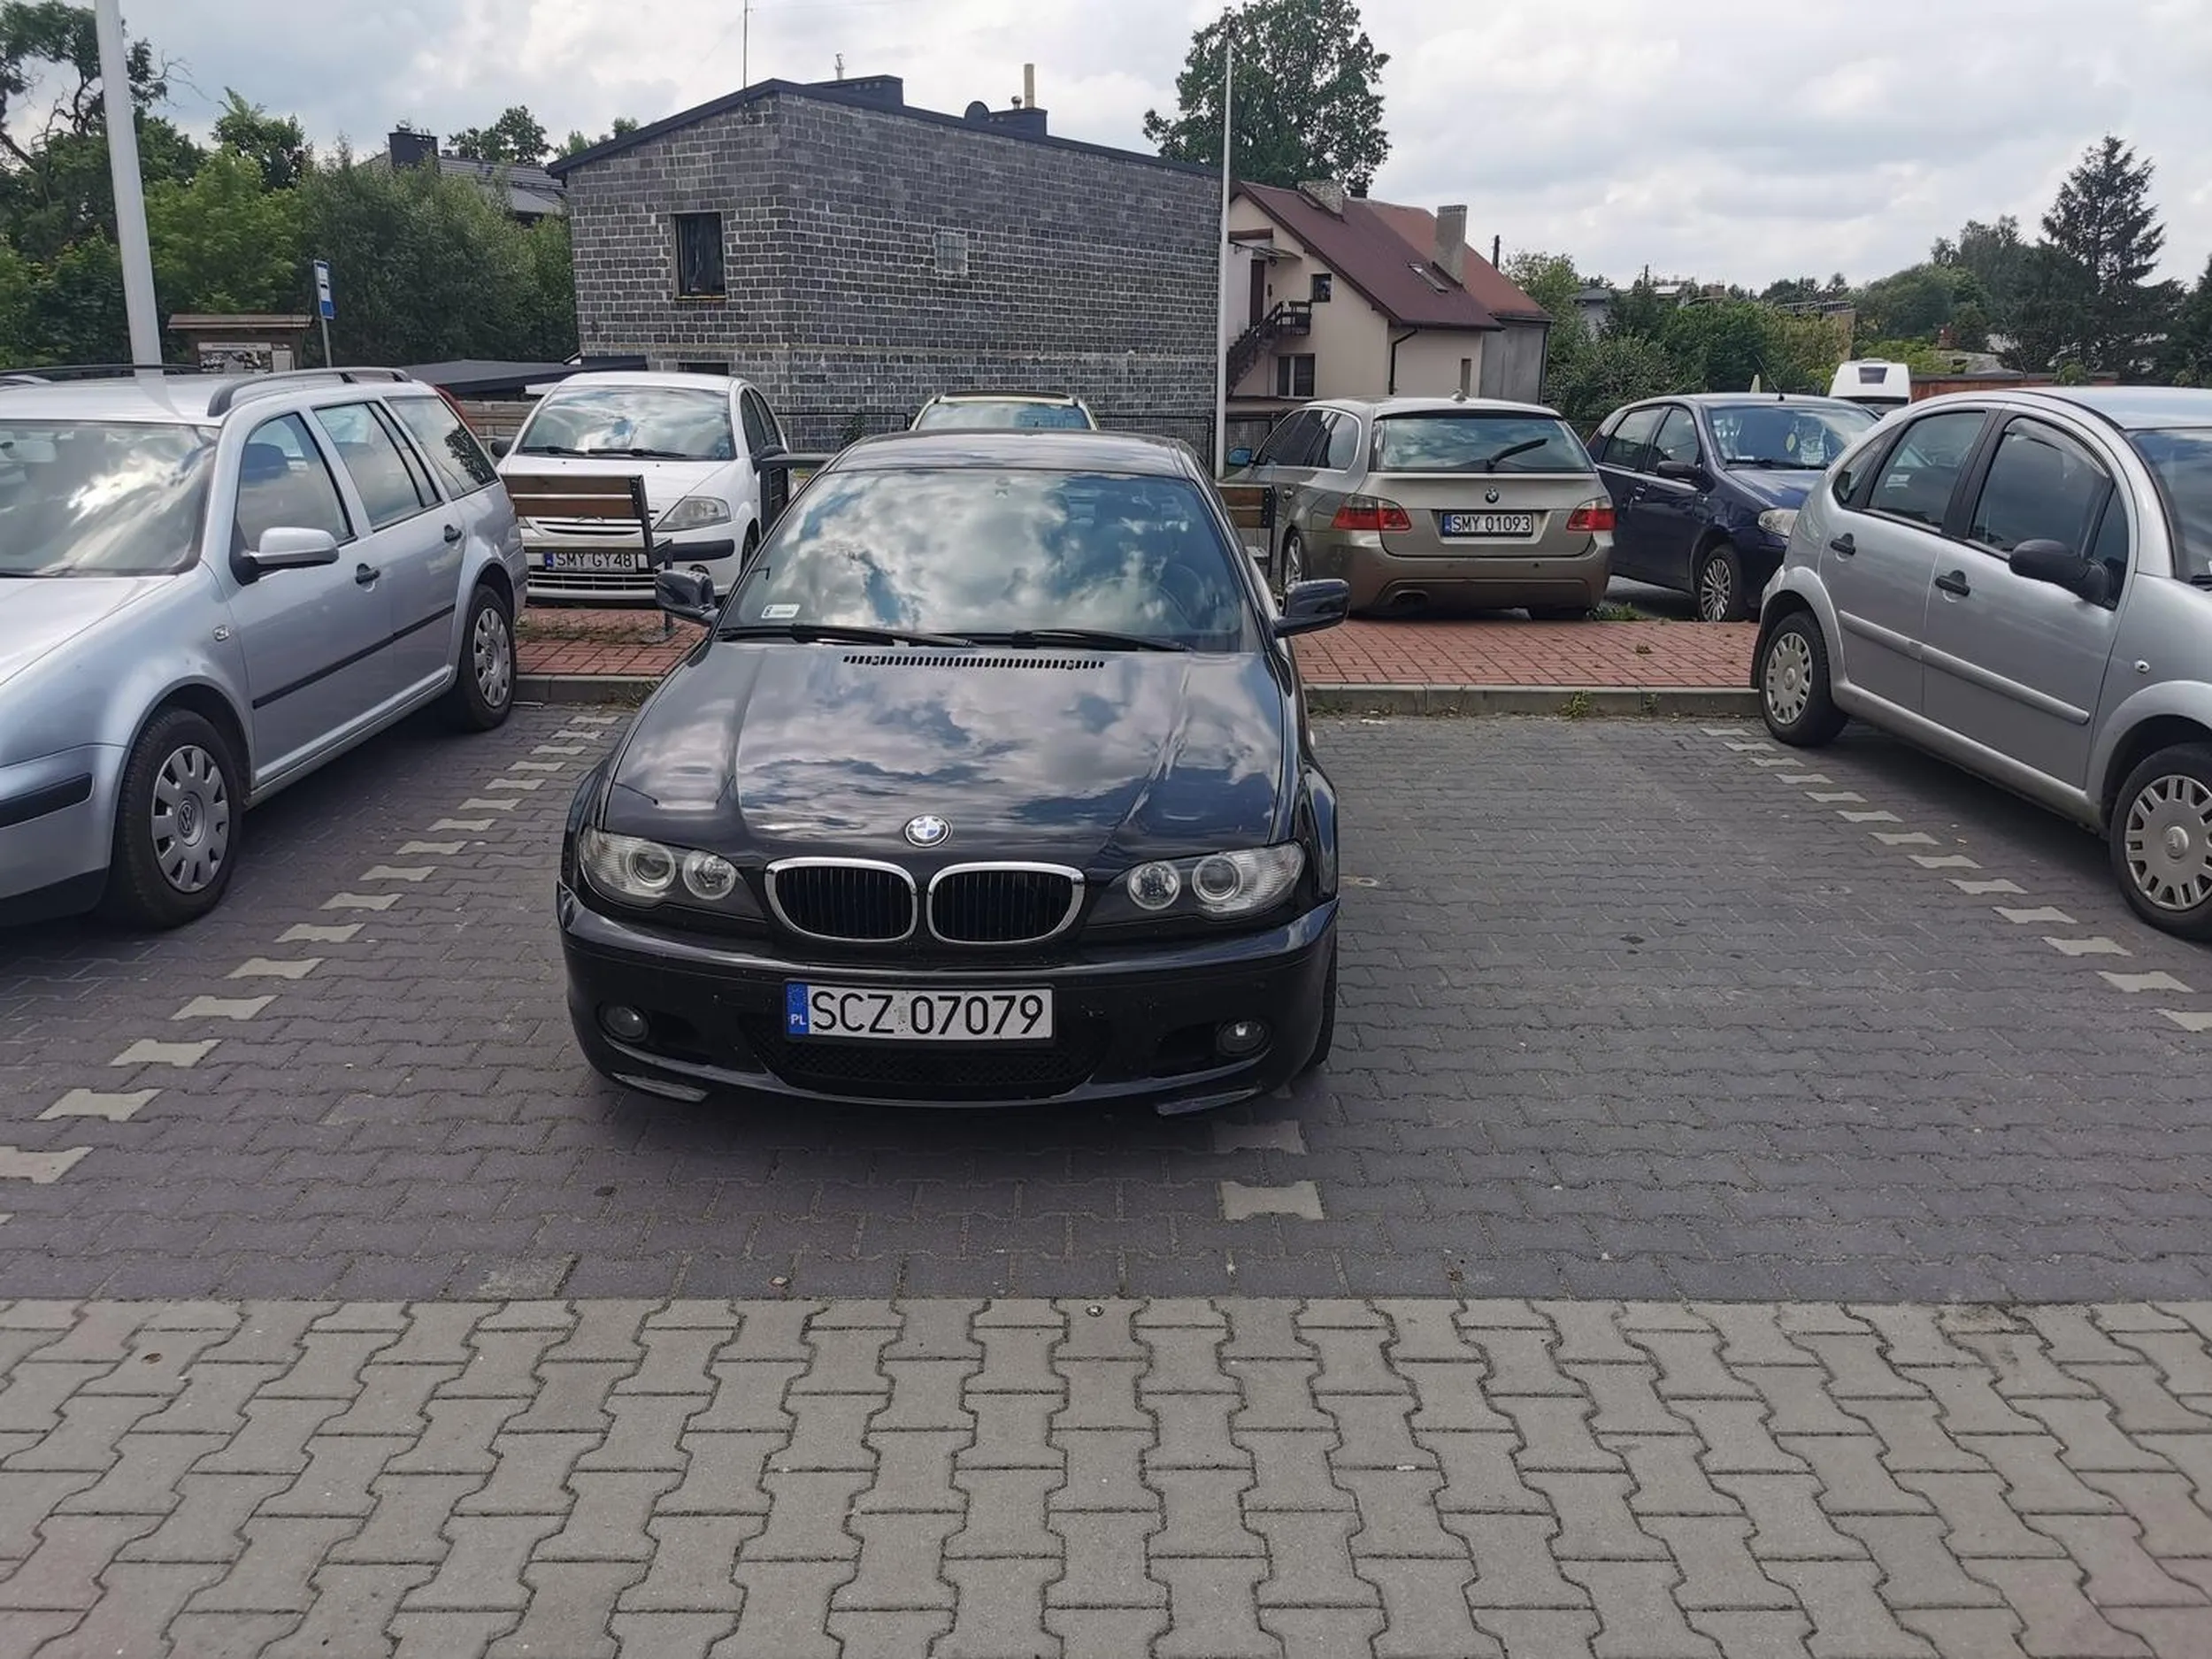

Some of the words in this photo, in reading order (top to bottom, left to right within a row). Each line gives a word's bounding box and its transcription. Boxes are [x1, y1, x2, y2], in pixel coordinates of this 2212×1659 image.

[1452, 516, 1480, 531] SMY
[1486, 516, 1530, 531] 01093
[556, 552, 585, 566] SMY
[592, 552, 633, 567] GY48
[790, 1014, 807, 1025] PL
[811, 991, 895, 1033] SCZ
[910, 995, 1044, 1035] 07079
